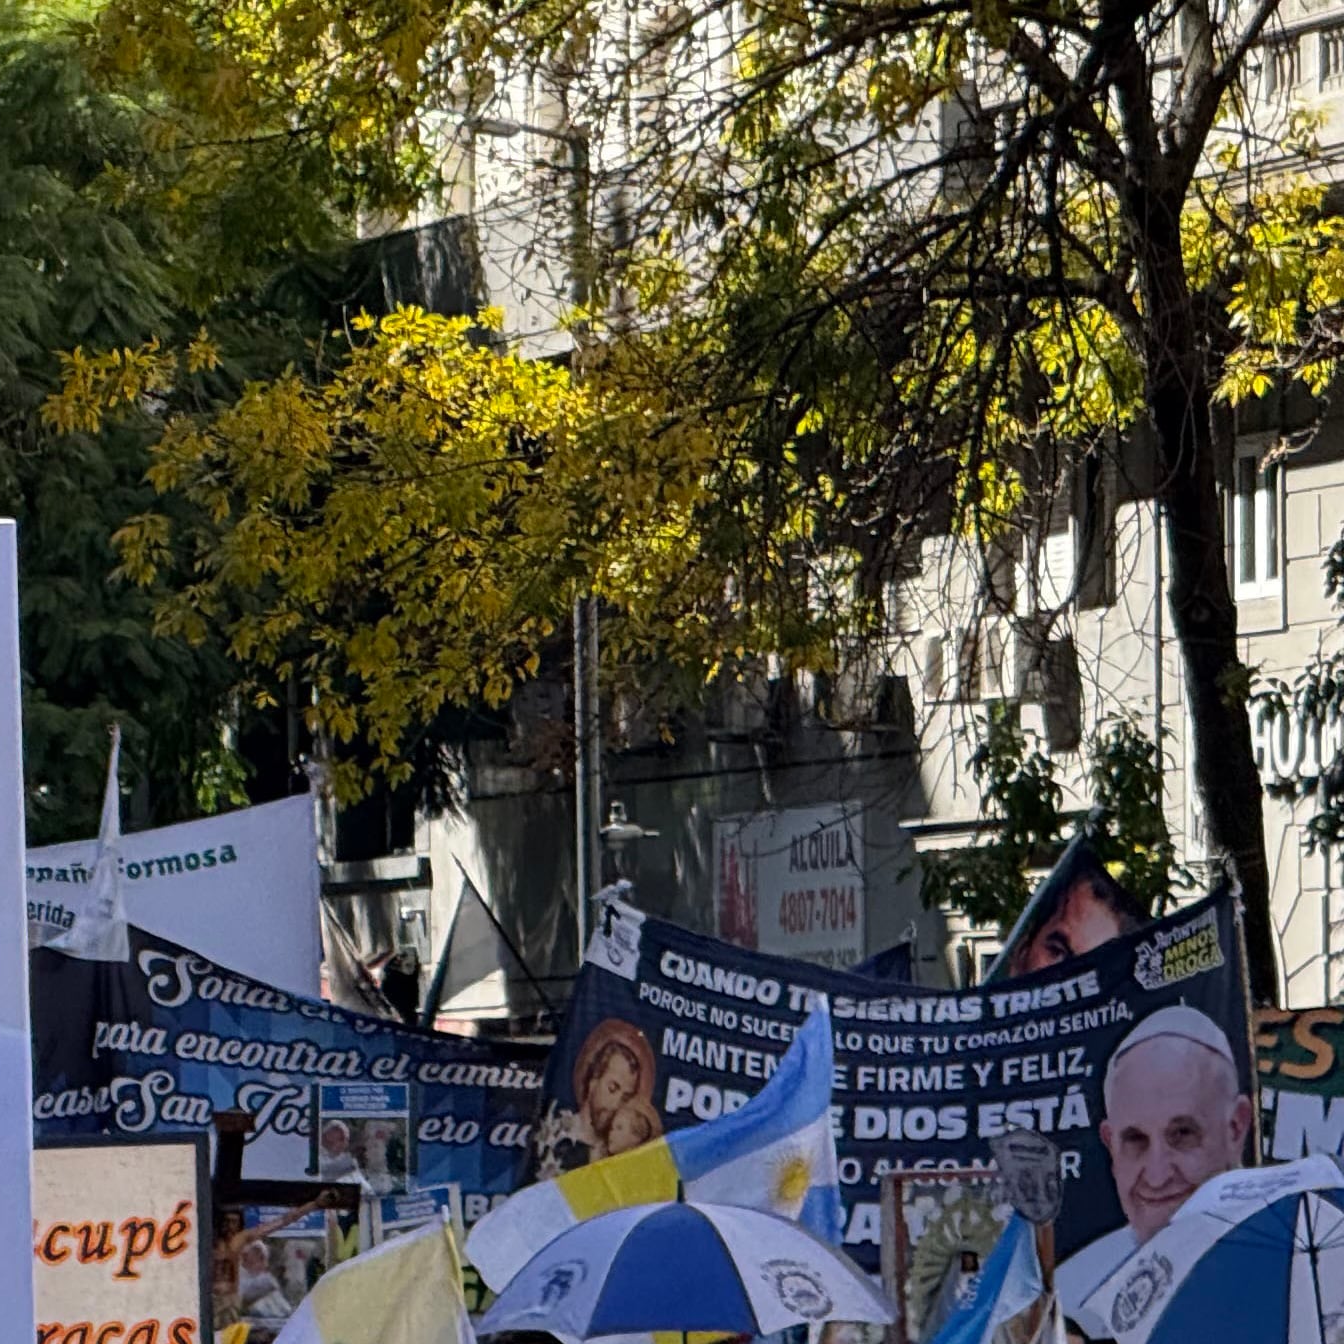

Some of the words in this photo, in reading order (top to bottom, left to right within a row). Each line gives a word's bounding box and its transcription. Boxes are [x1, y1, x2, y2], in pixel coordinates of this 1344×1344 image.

[118, 844, 238, 881] ormosa
[789, 829, 856, 873] ALQUILA
[778, 885, 857, 934] 4807-7014
[639, 982, 707, 1022] PORQUE
[709, 1007, 739, 1031] NO
[835, 1031, 862, 1051] LO
[868, 1036, 914, 1055] QUE
[919, 1035, 950, 1055] TU
[954, 1019, 1056, 1050] CORAZÓN
[660, 950, 780, 1006] CUANDO
[833, 996, 982, 1023] SIENTAS
[990, 970, 1101, 1018] TRISTE
[92, 1020, 168, 1060] para
[174, 1029, 364, 1076] encontrar
[371, 1053, 411, 1080] el
[418, 1062, 544, 1090] camin
[857, 1064, 966, 1092] FIRME
[972, 1062, 995, 1089] Y
[1002, 1047, 1093, 1085] FELIZ,
[33, 1085, 112, 1120] casa
[109, 1070, 212, 1133] San
[237, 1081, 312, 1147] Jos
[418, 1116, 480, 1143] ero
[854, 1104, 968, 1141] DIOS
[977, 1083, 1091, 1140] ESTÁ
[34, 1199, 194, 1281] cupé
